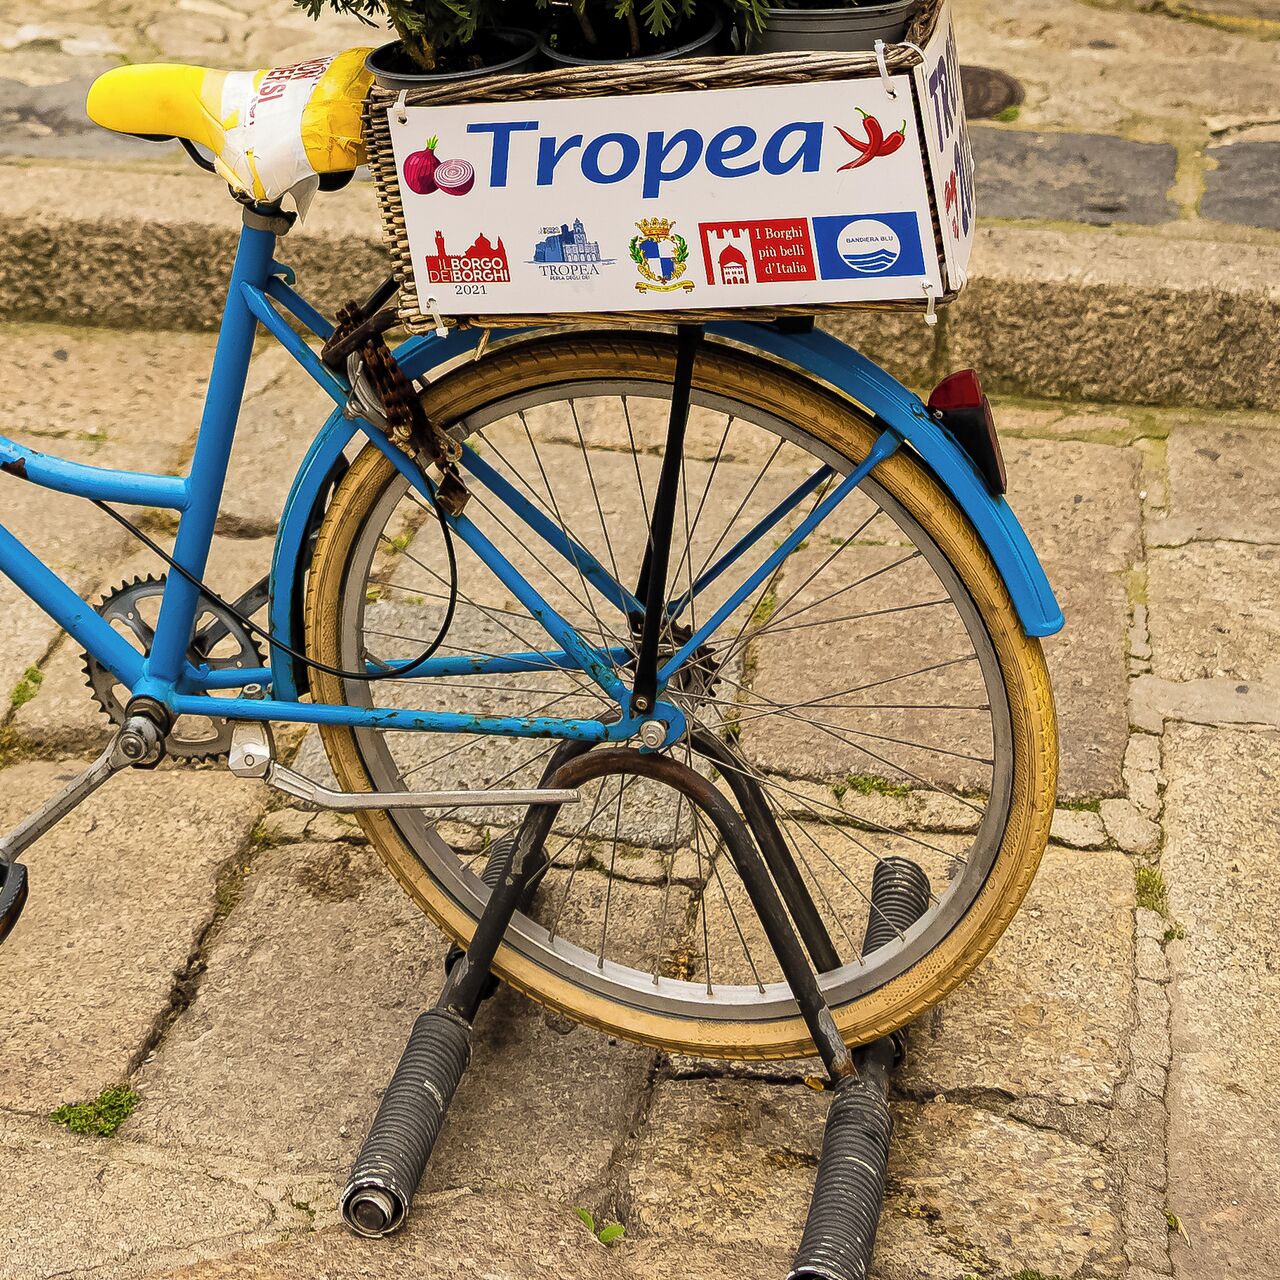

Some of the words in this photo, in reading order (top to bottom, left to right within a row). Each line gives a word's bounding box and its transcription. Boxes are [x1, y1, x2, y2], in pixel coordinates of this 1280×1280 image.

[466, 120, 824, 200] Tropea
[755, 228, 762, 240] I
[765, 226, 803, 241] Borghi
[845, 236, 880, 244] BANDIERA
[881, 235, 894, 243] BLU
[758, 246, 777, 261] più
[780, 245, 805, 258] belli
[451, 257, 503, 270] BORGO
[765, 262, 807, 275] d'Italia
[453, 269, 509, 282] BORGHI
[538, 264, 600, 277] TROPEA
[454, 285, 487, 295] 2021
